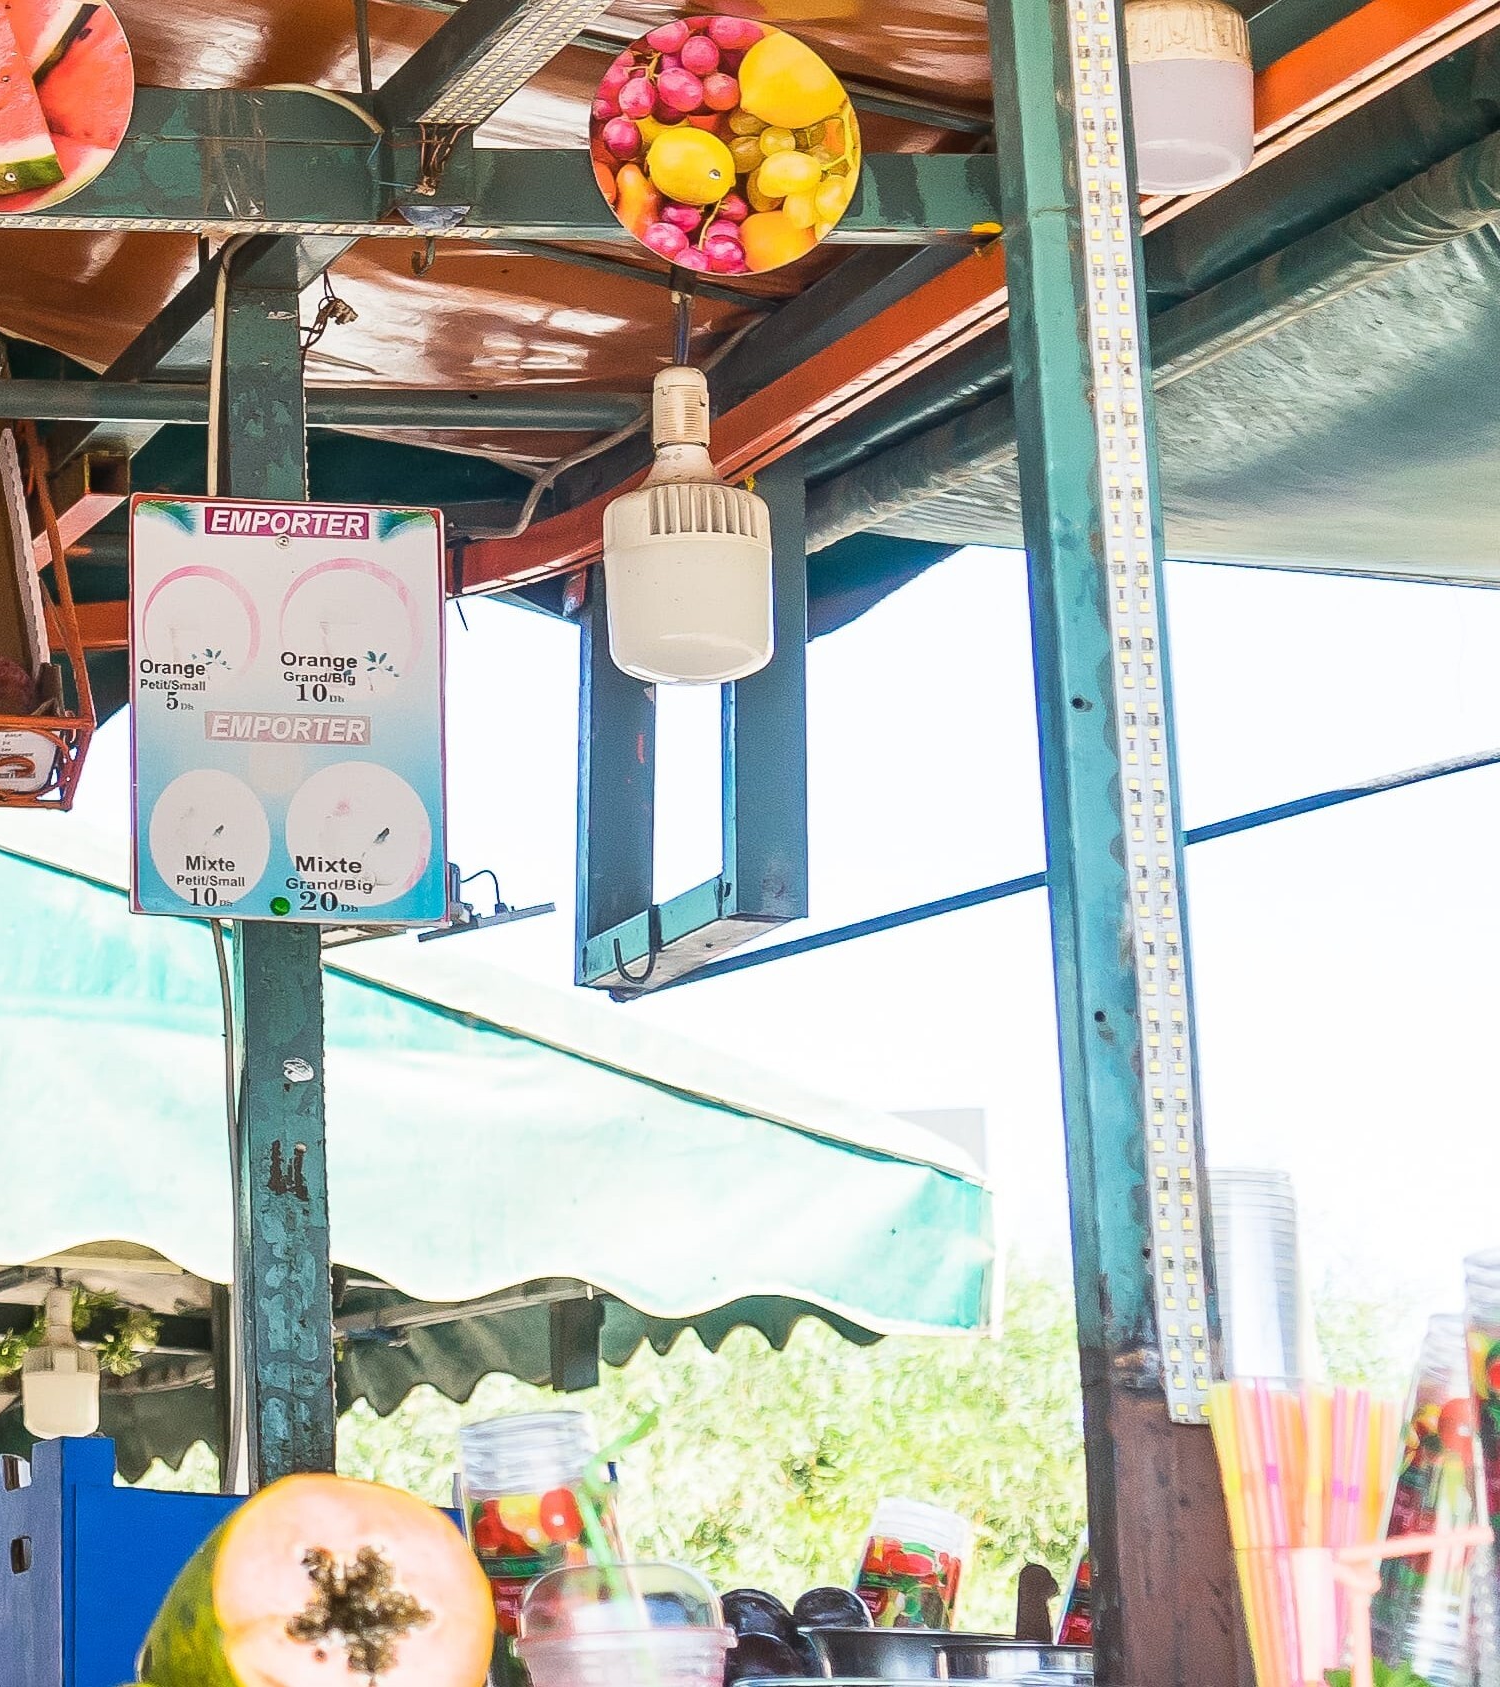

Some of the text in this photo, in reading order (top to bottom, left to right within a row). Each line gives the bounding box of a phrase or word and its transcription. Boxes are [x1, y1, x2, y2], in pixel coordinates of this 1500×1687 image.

[210, 509, 366, 538] EMPORTER
[140, 659, 206, 679] Orange
[280, 651, 358, 673] Orange
[140, 679, 206, 692] Petit/Small
[283, 671, 357, 686] Grand/Big
[166, 692, 179, 710] 5
[296, 684, 328, 702] 10
[210, 715, 366, 743] EMPORTER
[185, 856, 236, 872] Mixte
[295, 856, 362, 874] Mixte
[176, 875, 245, 888] Petit/Small
[285, 877, 373, 894] Grand/Big
[189, 888, 218, 907] 10
[299, 891, 339, 912] 20
